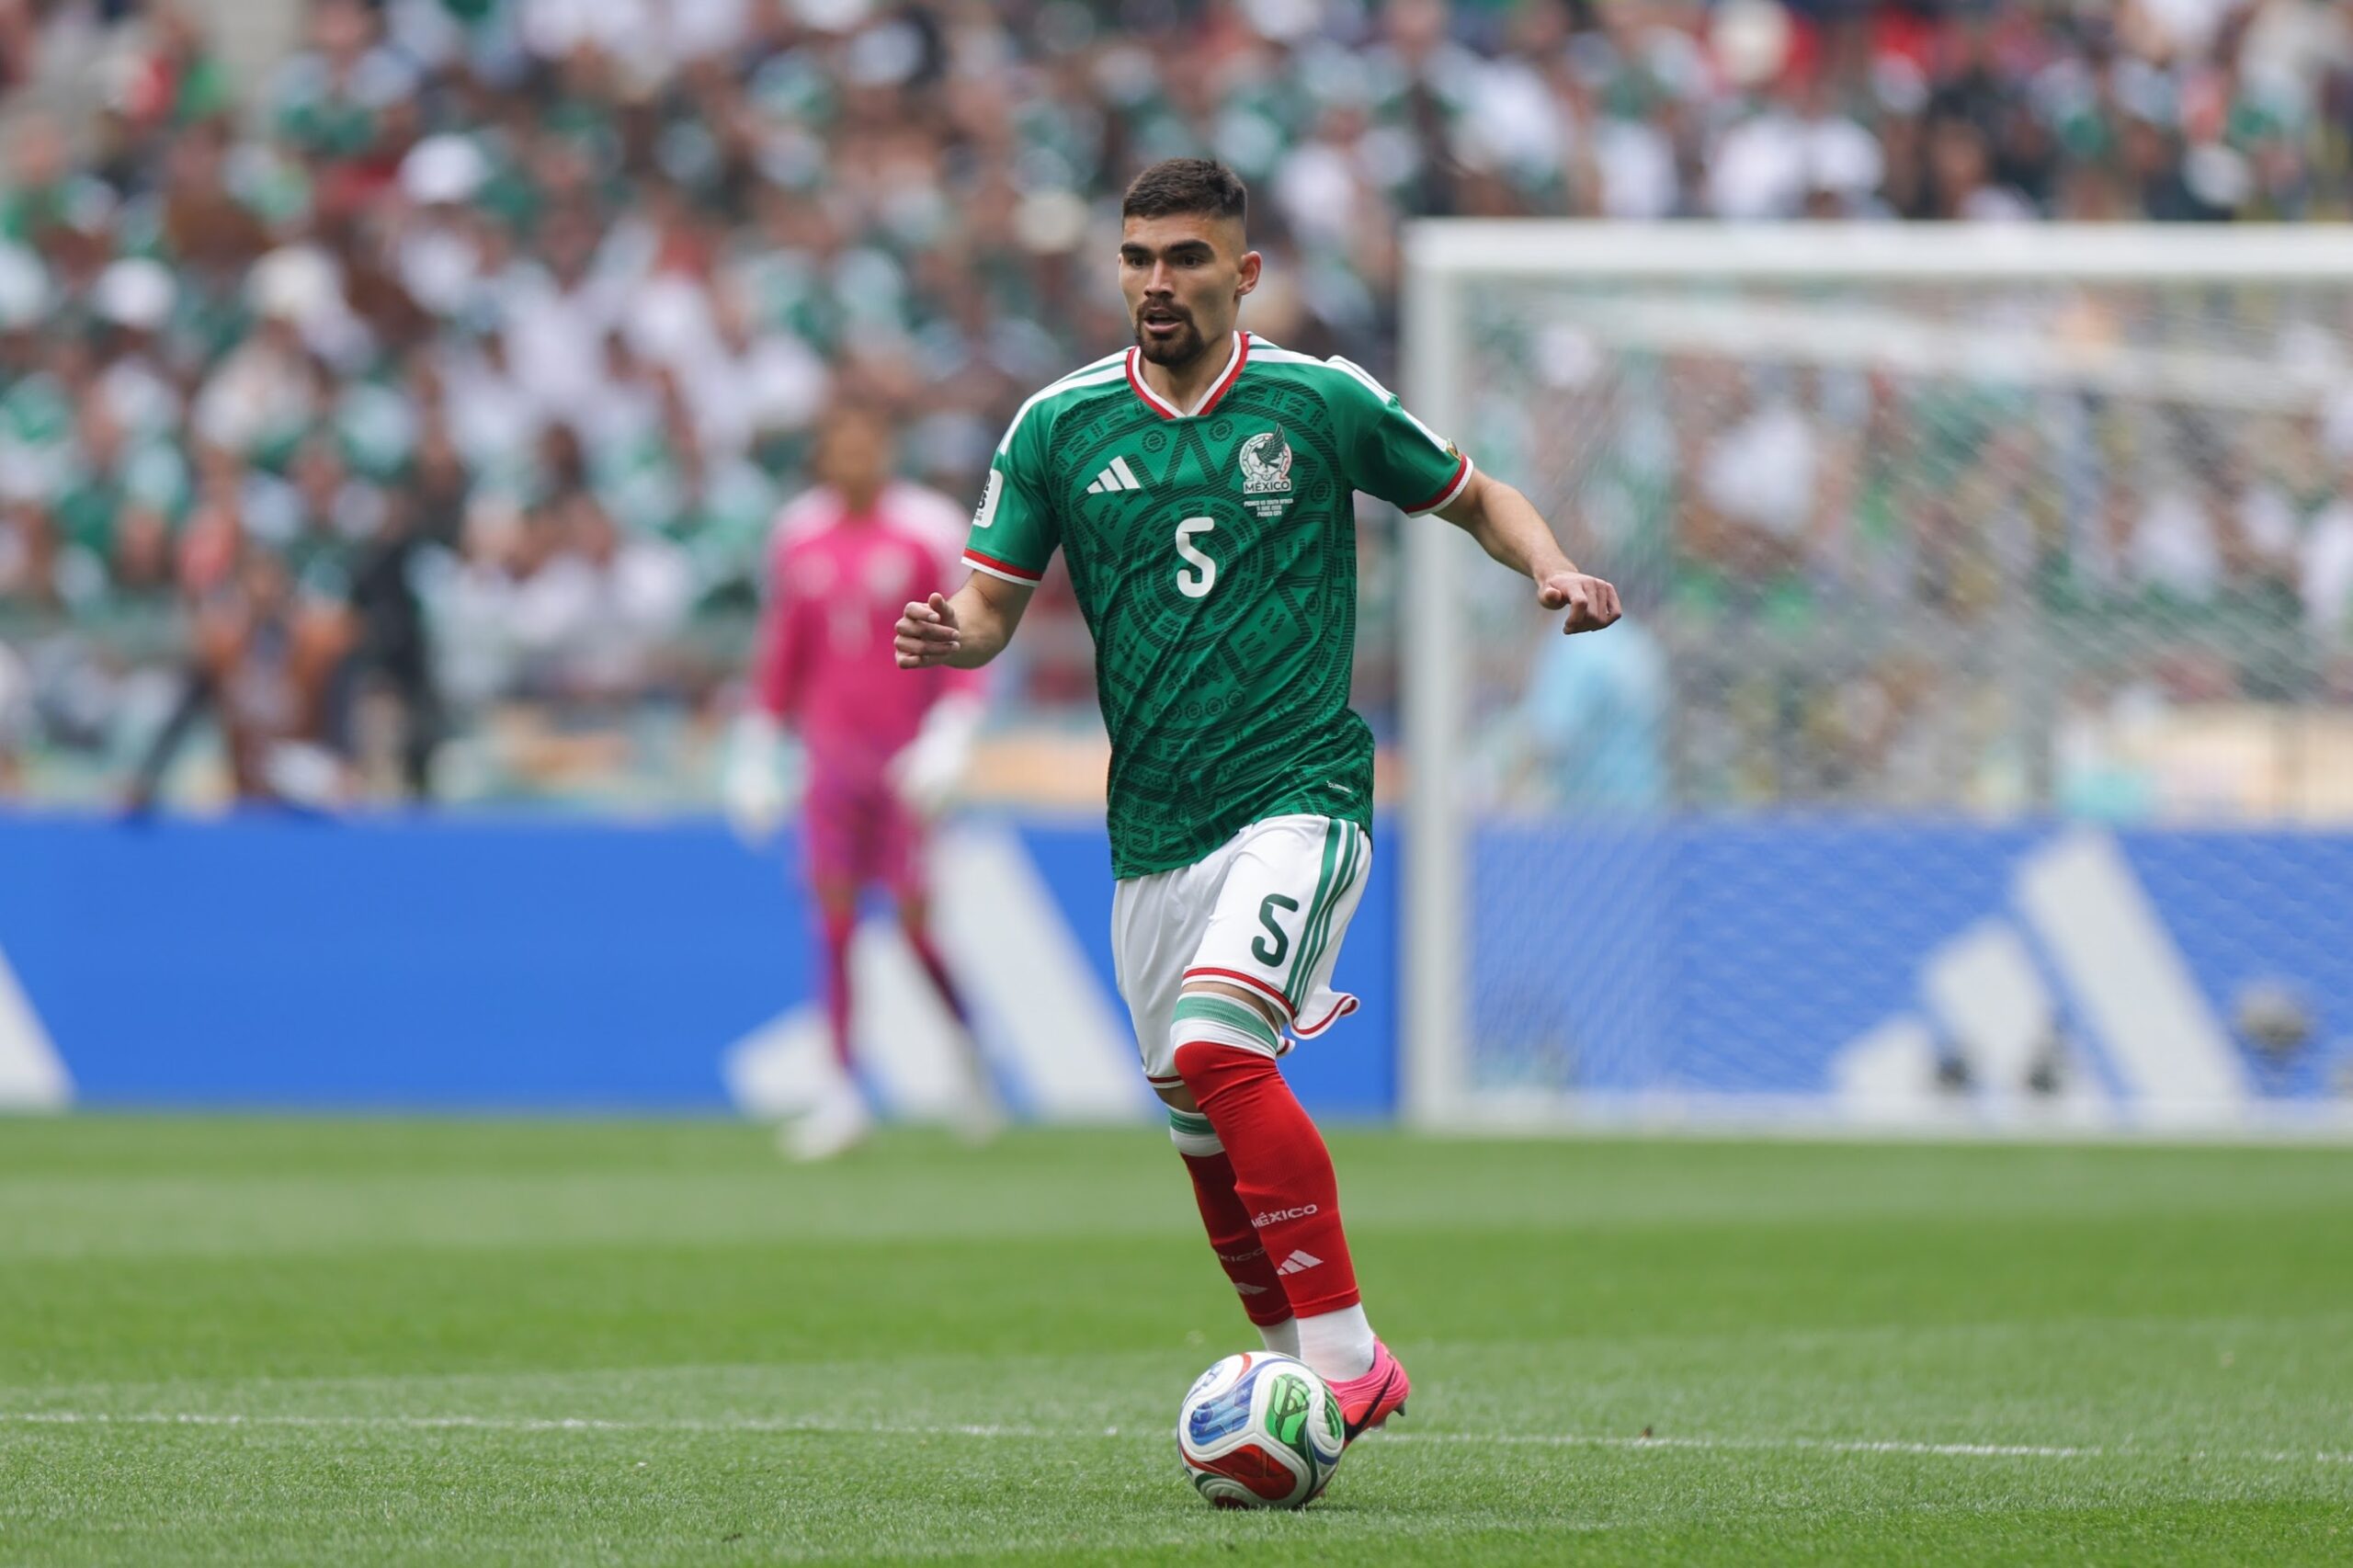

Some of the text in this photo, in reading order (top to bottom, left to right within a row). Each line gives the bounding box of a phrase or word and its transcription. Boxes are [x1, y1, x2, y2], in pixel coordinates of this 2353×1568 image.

[1245, 480, 1290, 492] MÉXICO
[1176, 517, 1216, 598] 5
[1251, 893, 1299, 968] 5
